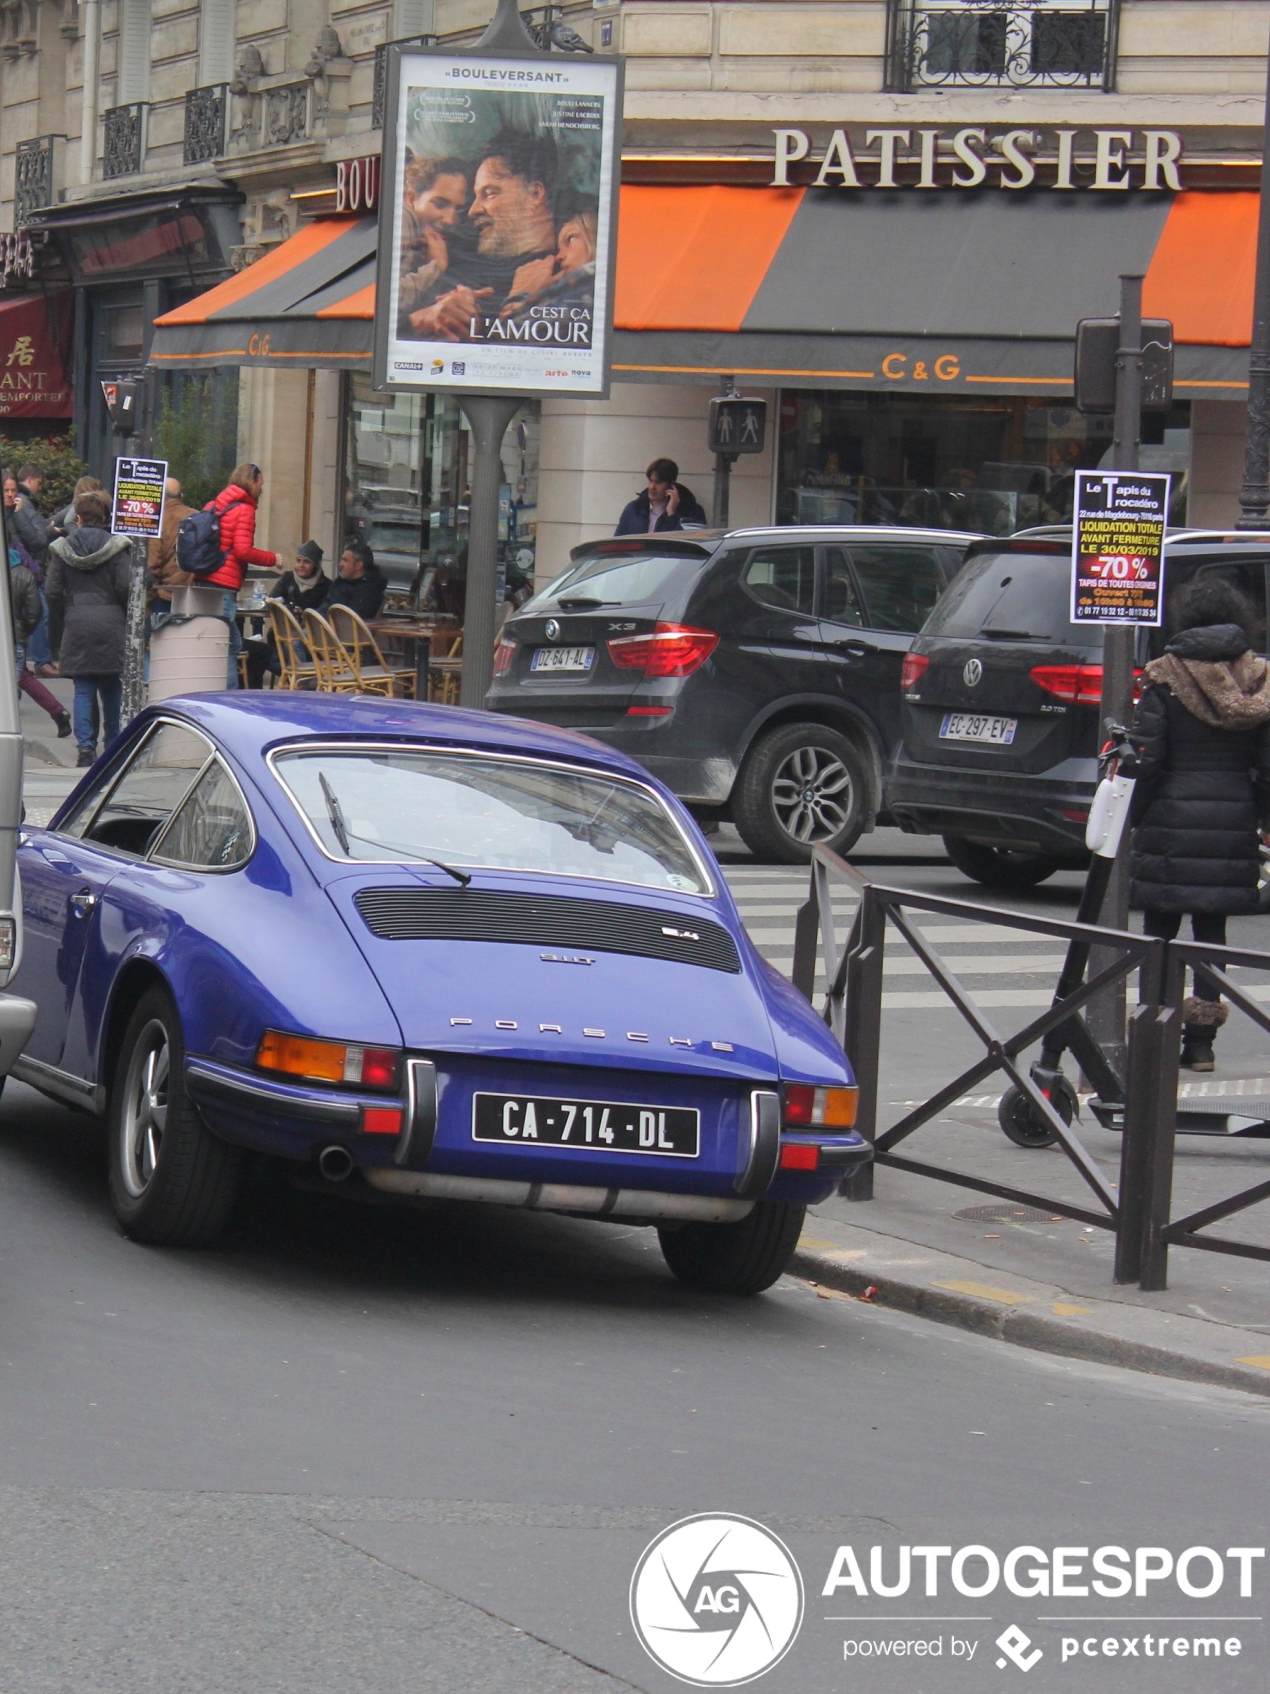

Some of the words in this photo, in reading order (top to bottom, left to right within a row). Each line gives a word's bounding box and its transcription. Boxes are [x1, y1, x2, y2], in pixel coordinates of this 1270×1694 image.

[444, 68, 569, 83] «BOULEVERSANT»
[768, 128, 1184, 190] PATISSIER
[530, 306, 567, 319] C'EST
[570, 308, 590, 321] ÇA
[470, 317, 590, 343] L'AMOUR
[395, 361, 422, 370] CANAL+
[545, 369, 568, 377] arte
[1086, 483, 1101, 493] Le
[1140, 486, 1151, 496] du
[1080, 521, 1136, 533] LIQUIDATION
[1137, 523, 1163, 534] TOTALE
[1080, 533, 1111, 543] AVANT
[1113, 535, 1160, 545] FERMETURE
[1080, 544, 1097, 554] LE
[1101, 545, 1159, 556] 30/03/2019
[1078, 579, 1098, 587] TAPIS
[1098, 579, 1108, 588] DE
[1109, 580, 1134, 588] TOUTES
[1092, 607, 1100, 615] 77
[608, 622, 636, 631] X3
[538, 650, 584, 667] DZ-641-AL
[949, 715, 1008, 739] EC-297-EV
[450, 1017, 734, 1053] PORSCHE
[502, 1100, 674, 1149] CA-714-DL
